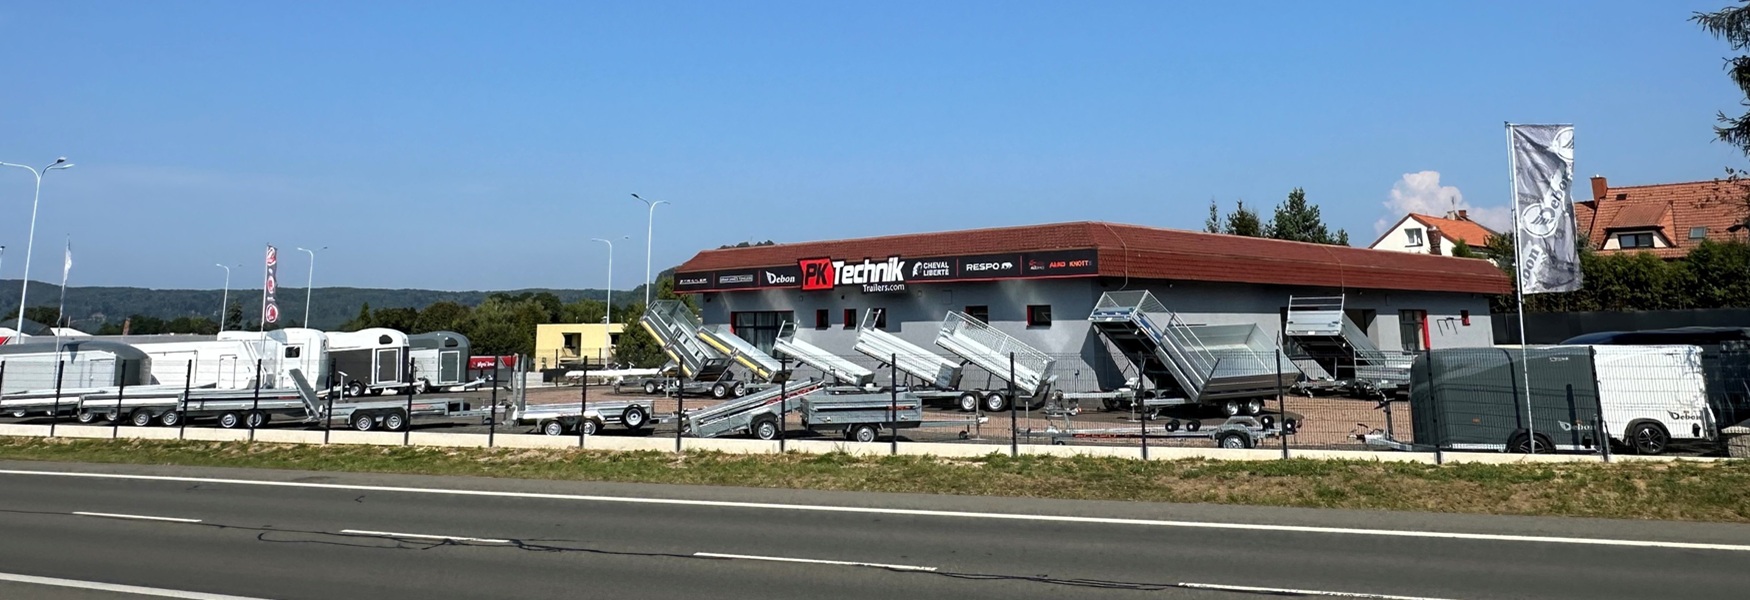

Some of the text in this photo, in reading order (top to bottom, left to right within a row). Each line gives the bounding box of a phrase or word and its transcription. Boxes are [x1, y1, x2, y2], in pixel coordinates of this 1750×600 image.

[923, 261, 950, 269] CHEVAL
[966, 262, 1000, 271] RESPO
[804, 256, 905, 286] PK Technik
[766, 271, 795, 284] Debon
[862, 283, 905, 292] Trailers.com
